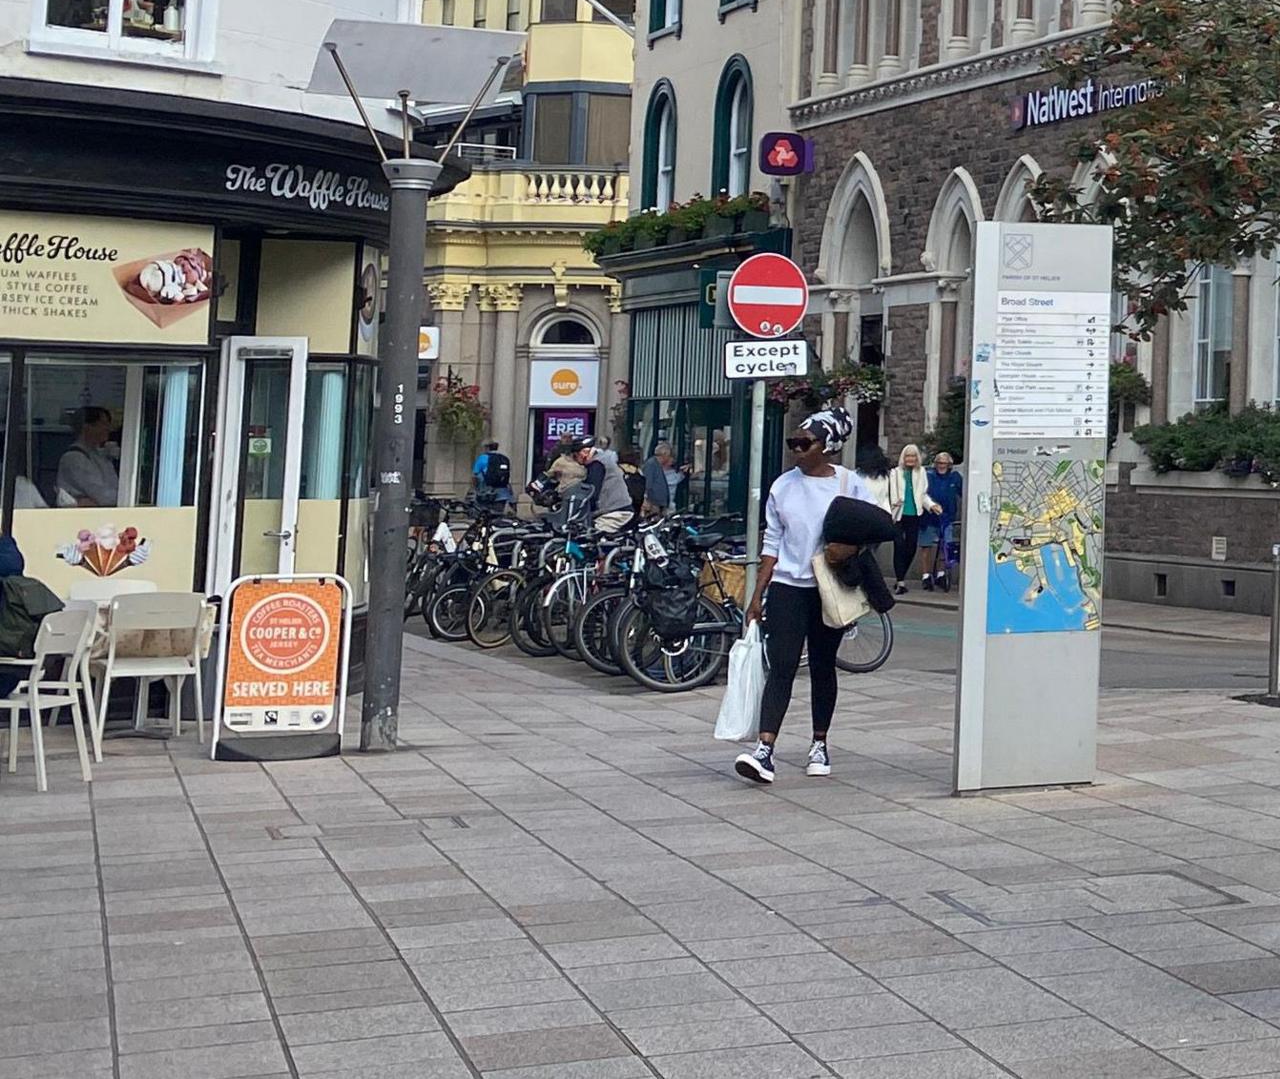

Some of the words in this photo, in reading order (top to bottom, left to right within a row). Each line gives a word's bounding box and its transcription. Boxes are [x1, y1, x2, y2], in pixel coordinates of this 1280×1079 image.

[1026, 78, 1094, 126] NatWest
[225, 164, 266, 192] The
[265, 163, 344, 210] Waffle
[345, 176, 390, 211] House
[0, 232, 45, 264] ffle
[47, 235, 118, 262] House
[26, 270, 77, 281] WAFFLES
[7, 281, 40, 291] STYLE
[45, 283, 88, 294] COFFEE
[36, 295, 54, 305] ICE
[58, 296, 98, 306] CREAM
[1001, 297, 1026, 306] Broad
[1028, 297, 1054, 306] Street
[2, 306, 38, 316] THICK
[43, 308, 88, 318] SHAKES
[733, 344, 800, 358] Except
[552, 381, 577, 390] sure
[394, 383, 404, 424] 1993
[548, 422, 584, 435] FREE
[252, 600, 281, 623] COFFEE
[283, 599, 320, 624] ROASTERS
[249, 627, 297, 639] COOPER
[298, 627, 308, 639] &
[251, 643, 264, 660] TEA
[265, 644, 318, 668] MERCHANTS
[232, 681, 288, 697] SERVED
[292, 680, 330, 696] HERE
